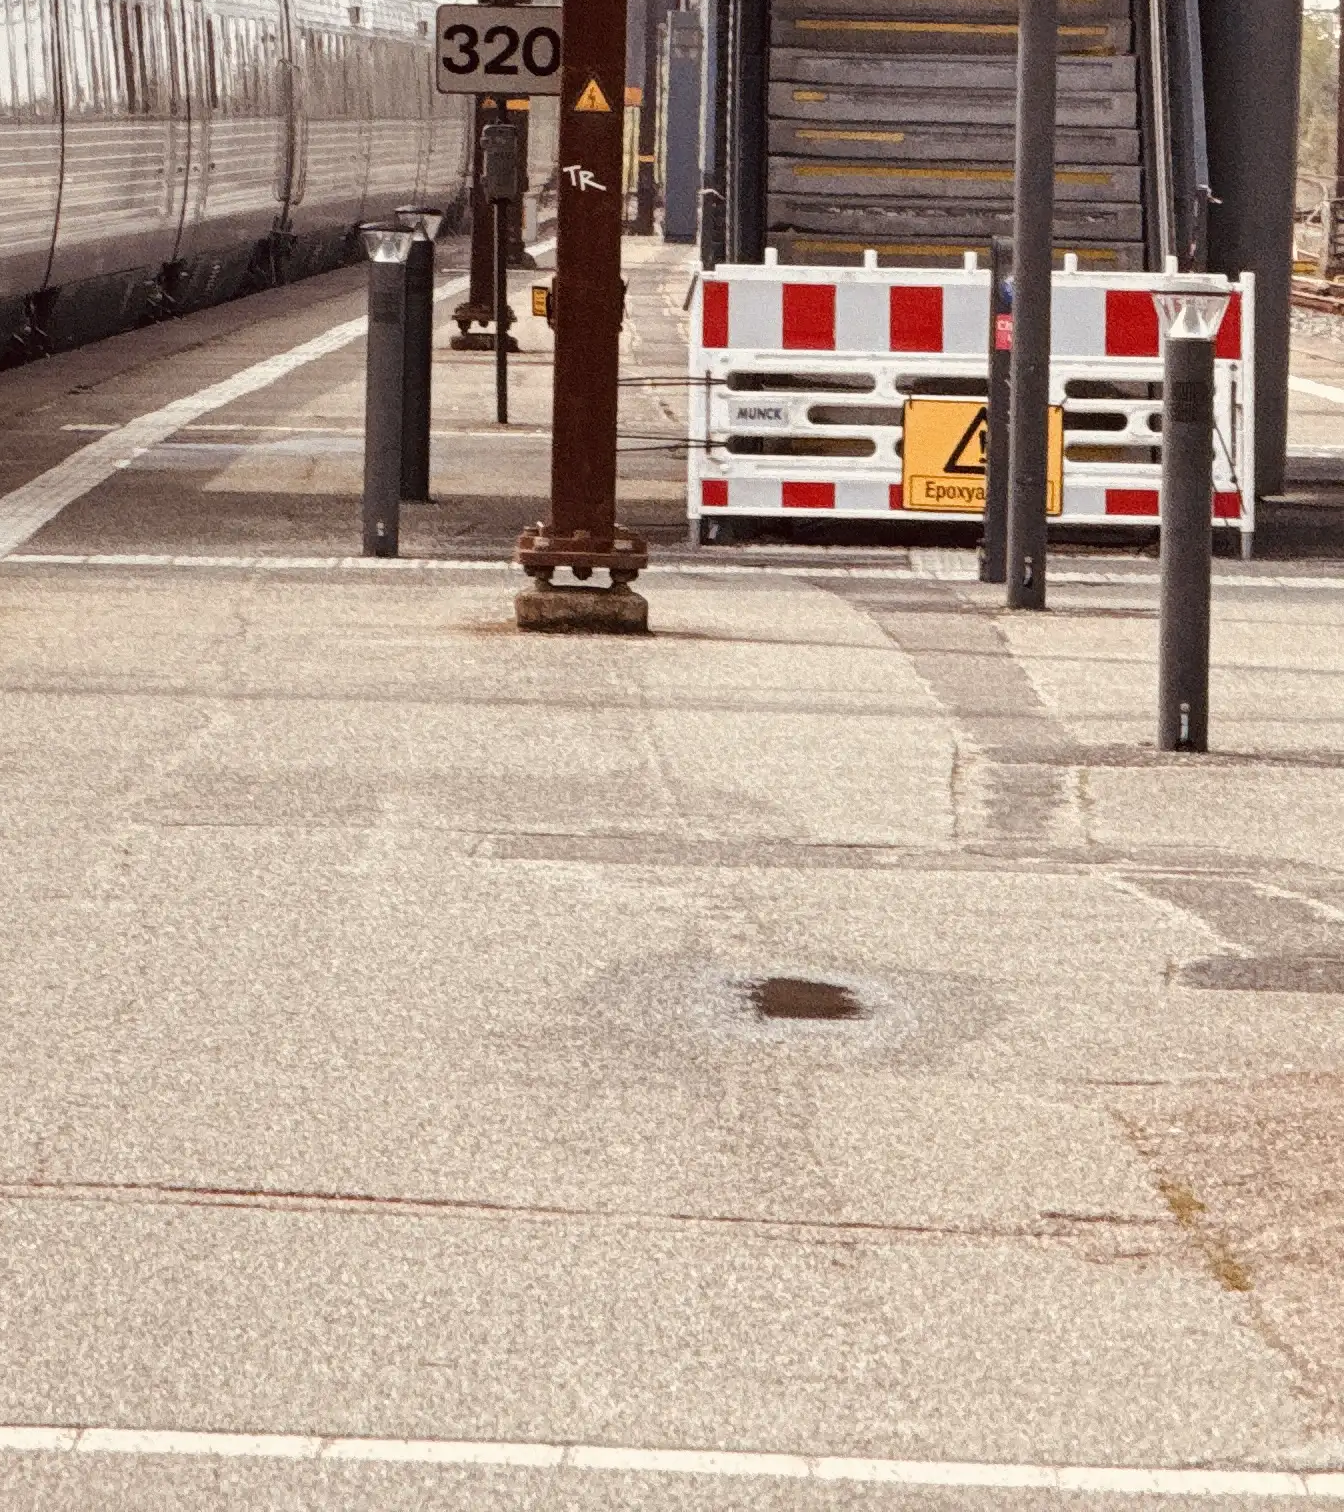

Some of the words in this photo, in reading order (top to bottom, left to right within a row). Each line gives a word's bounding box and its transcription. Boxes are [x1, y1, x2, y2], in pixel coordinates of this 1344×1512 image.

[442, 23, 561, 77] 320
[562, 164, 607, 192] TR
[736, 407, 783, 420] MUNCK
[924, 480, 985, 503] Epoxya
